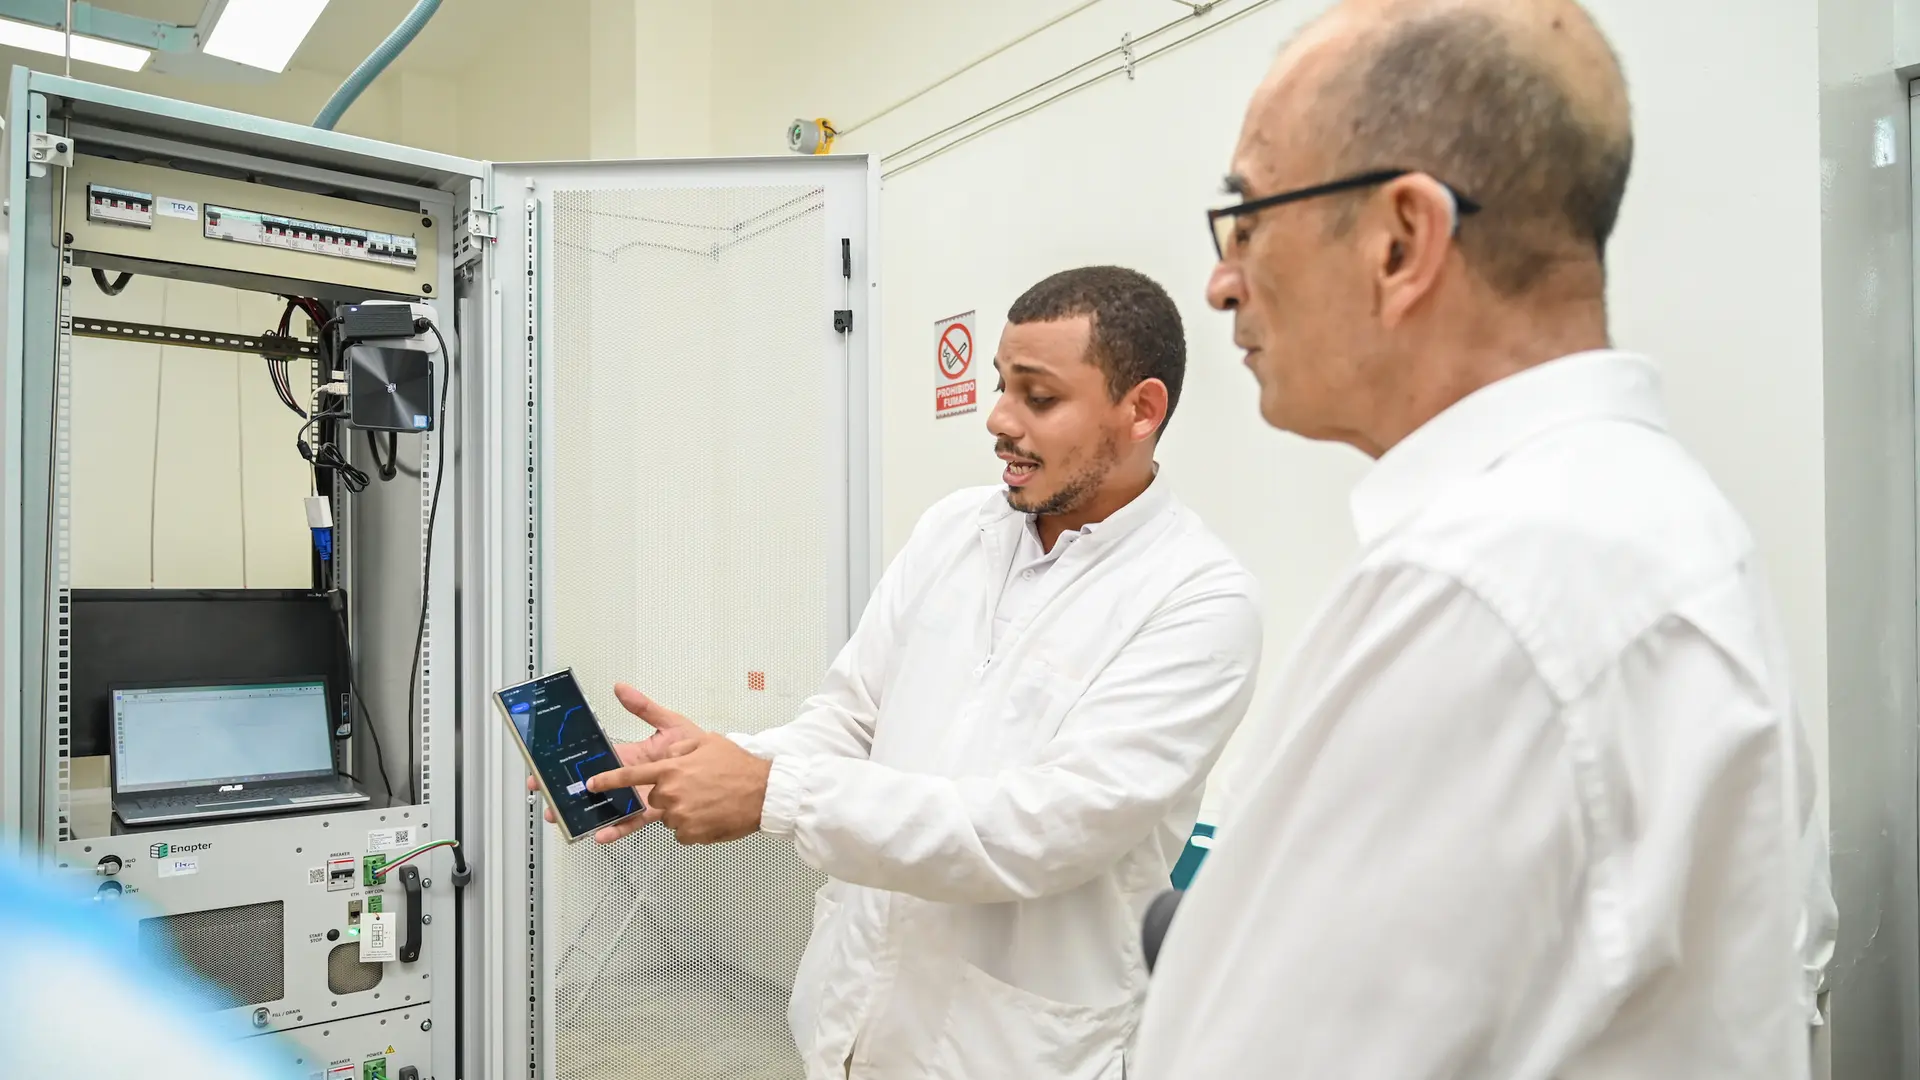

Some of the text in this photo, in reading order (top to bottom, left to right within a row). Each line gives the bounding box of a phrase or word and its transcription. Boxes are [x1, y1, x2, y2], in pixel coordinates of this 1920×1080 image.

[171, 202, 195, 212] TRA
[937, 382, 975, 398] PROHIBIDO
[944, 394, 969, 408] FUMAR
[219, 784, 244, 792] ASUS
[170, 842, 213, 853] Enapter
[285, 1008, 301, 1016] DRAIN
[330, 1057, 351, 1066] BREAKER
